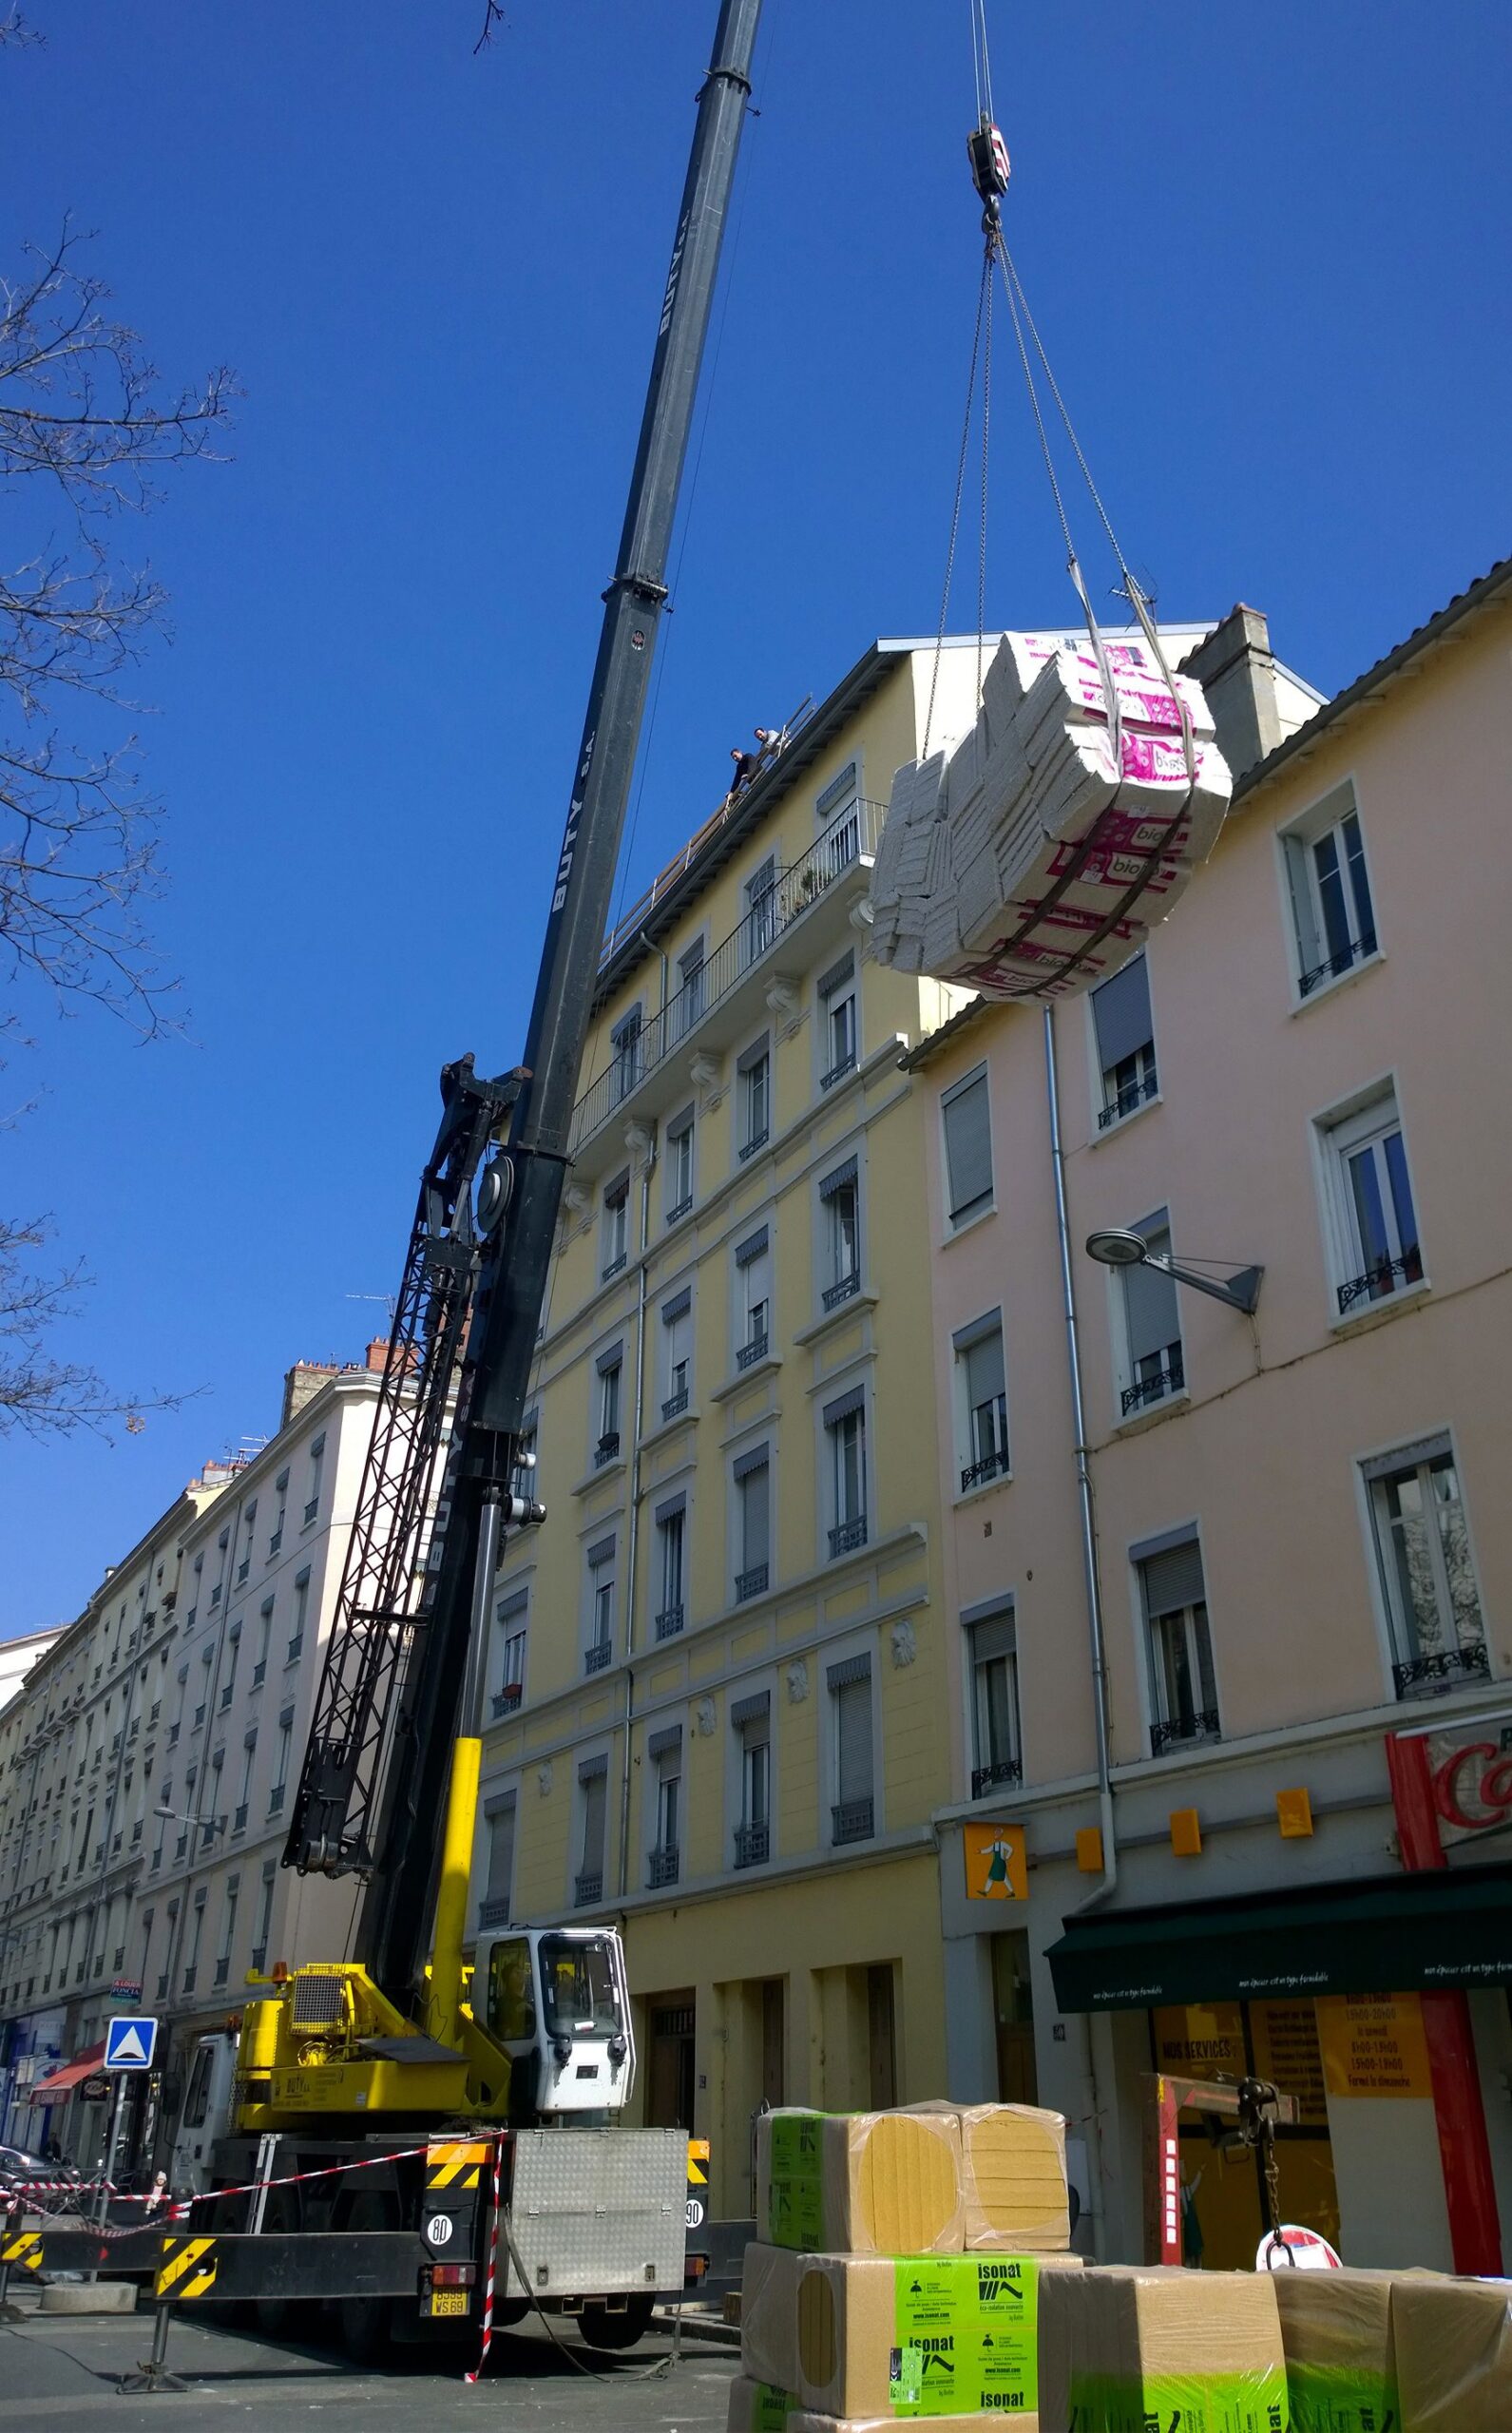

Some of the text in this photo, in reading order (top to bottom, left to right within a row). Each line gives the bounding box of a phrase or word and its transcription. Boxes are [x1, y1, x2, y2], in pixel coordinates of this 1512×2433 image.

[660, 251, 683, 336] BUTY
[552, 730, 598, 913] BUTY S.A.
[428, 1428, 464, 1572] BUTY
[1162, 2040, 1182, 2059] NOS
[1185, 2038, 1232, 2059] SERVICES
[686, 2203, 699, 2225] 90
[978, 2263, 1023, 2279] isonat
[450, 2300, 464, 2312] 69
[909, 2335, 954, 2352] isonat
[980, 2390, 1024, 2407] isonat
